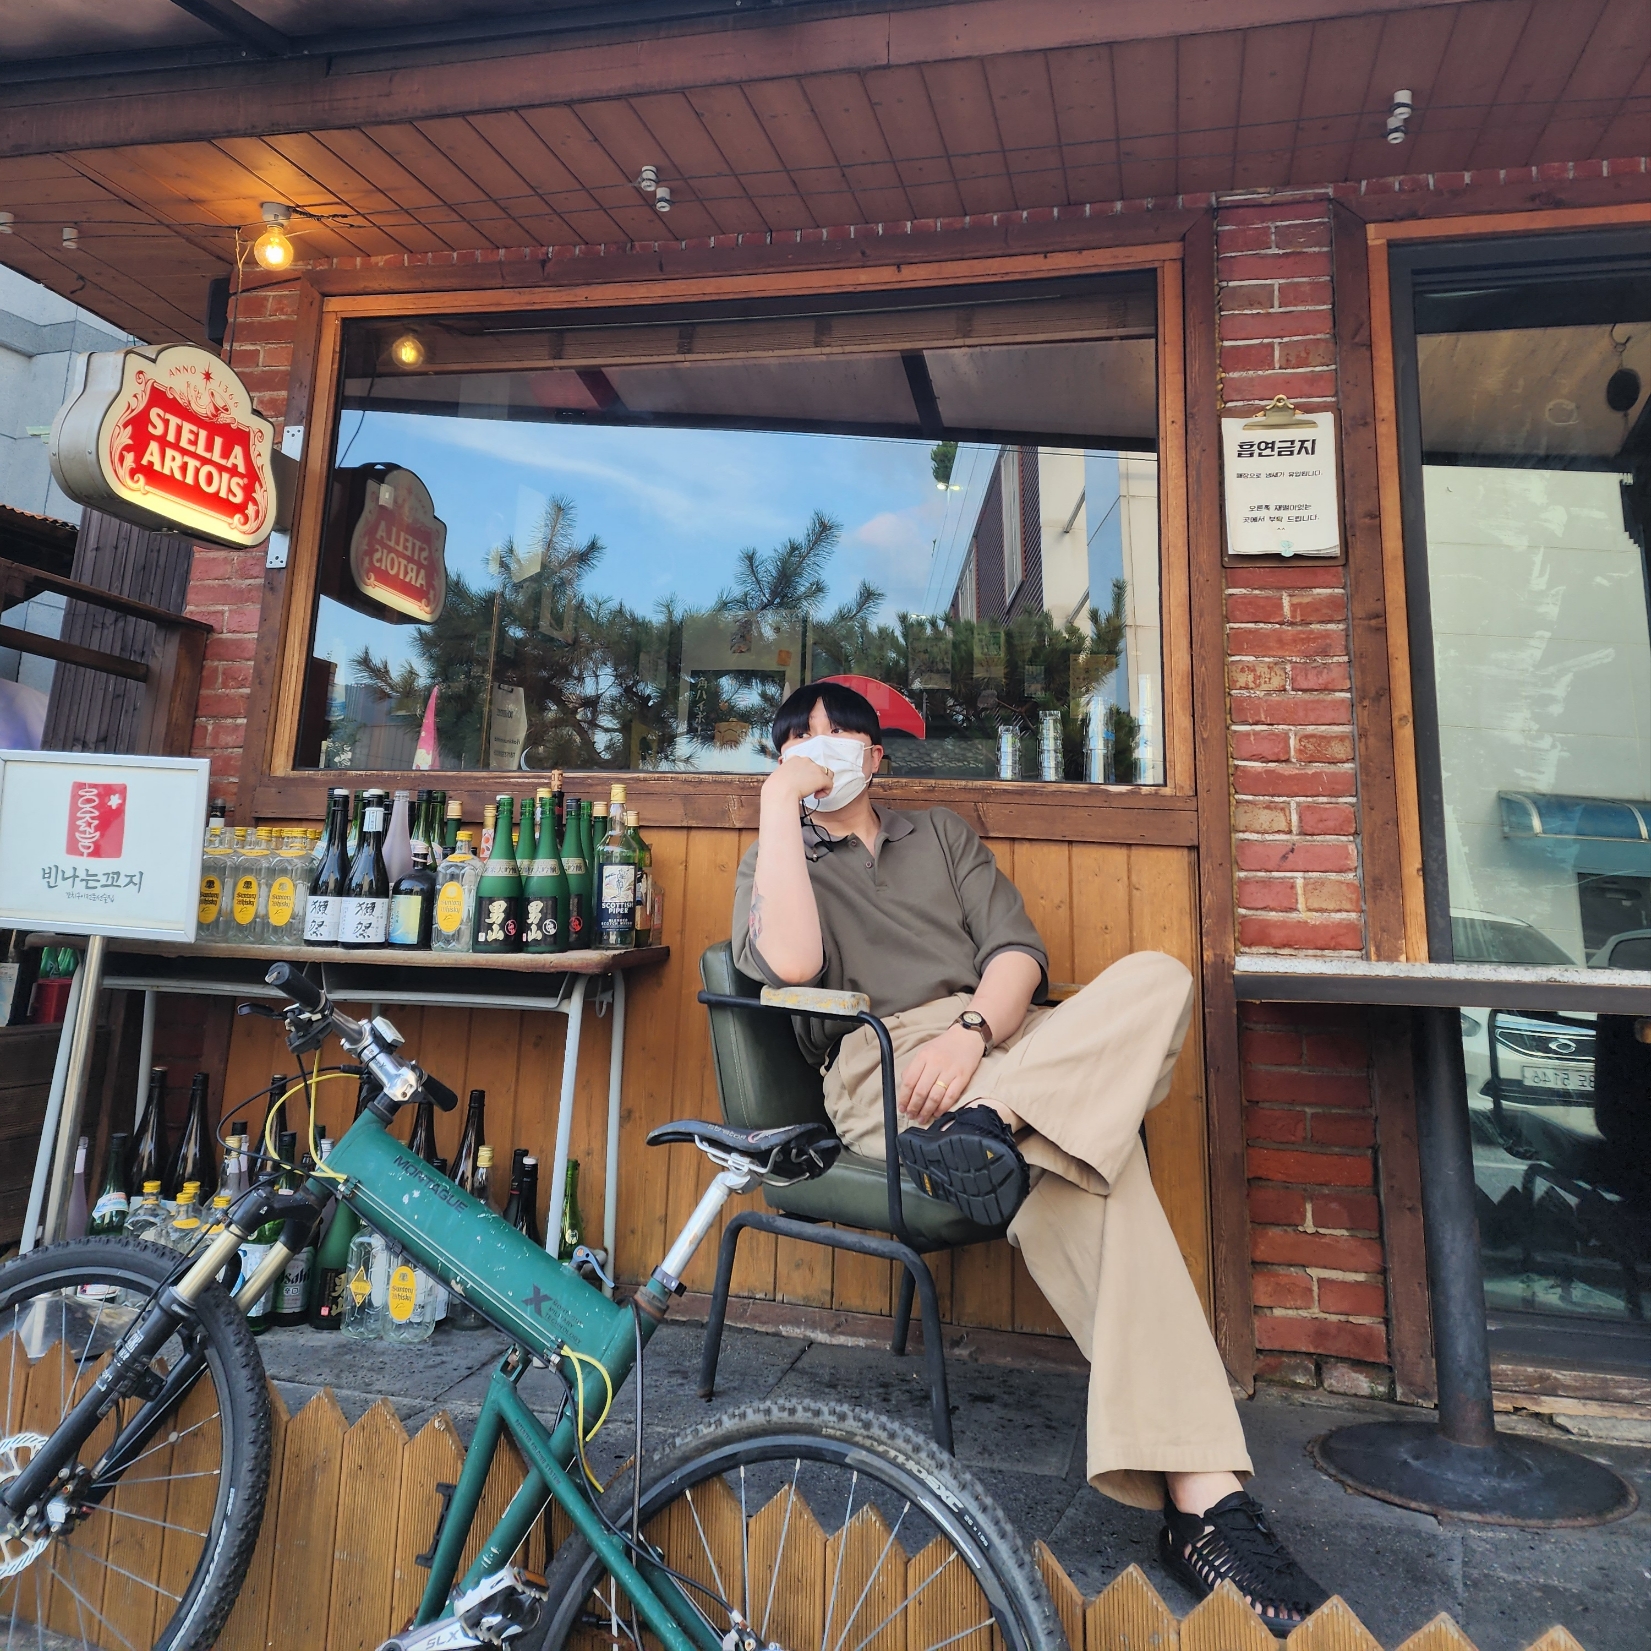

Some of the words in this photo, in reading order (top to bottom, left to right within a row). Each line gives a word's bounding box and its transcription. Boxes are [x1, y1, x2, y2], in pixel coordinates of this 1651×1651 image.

[168, 364, 197, 378] ANNO
[217, 380, 239, 408] 1366
[148, 406, 247, 474] STELLA
[1236, 438, 1317, 458] 흡연금지
[141, 441, 245, 504] ARTOIS
[1242, 515, 1265, 524] 곳에서
[41, 864, 144, 894] 빈나는꼬지
[601, 901, 634, 909] SCOTTISH
[392, 1154, 470, 1213] MONTAGUE
[391, 1285, 414, 1294] Suntory
[426, 1629, 460, 1650] SLX
